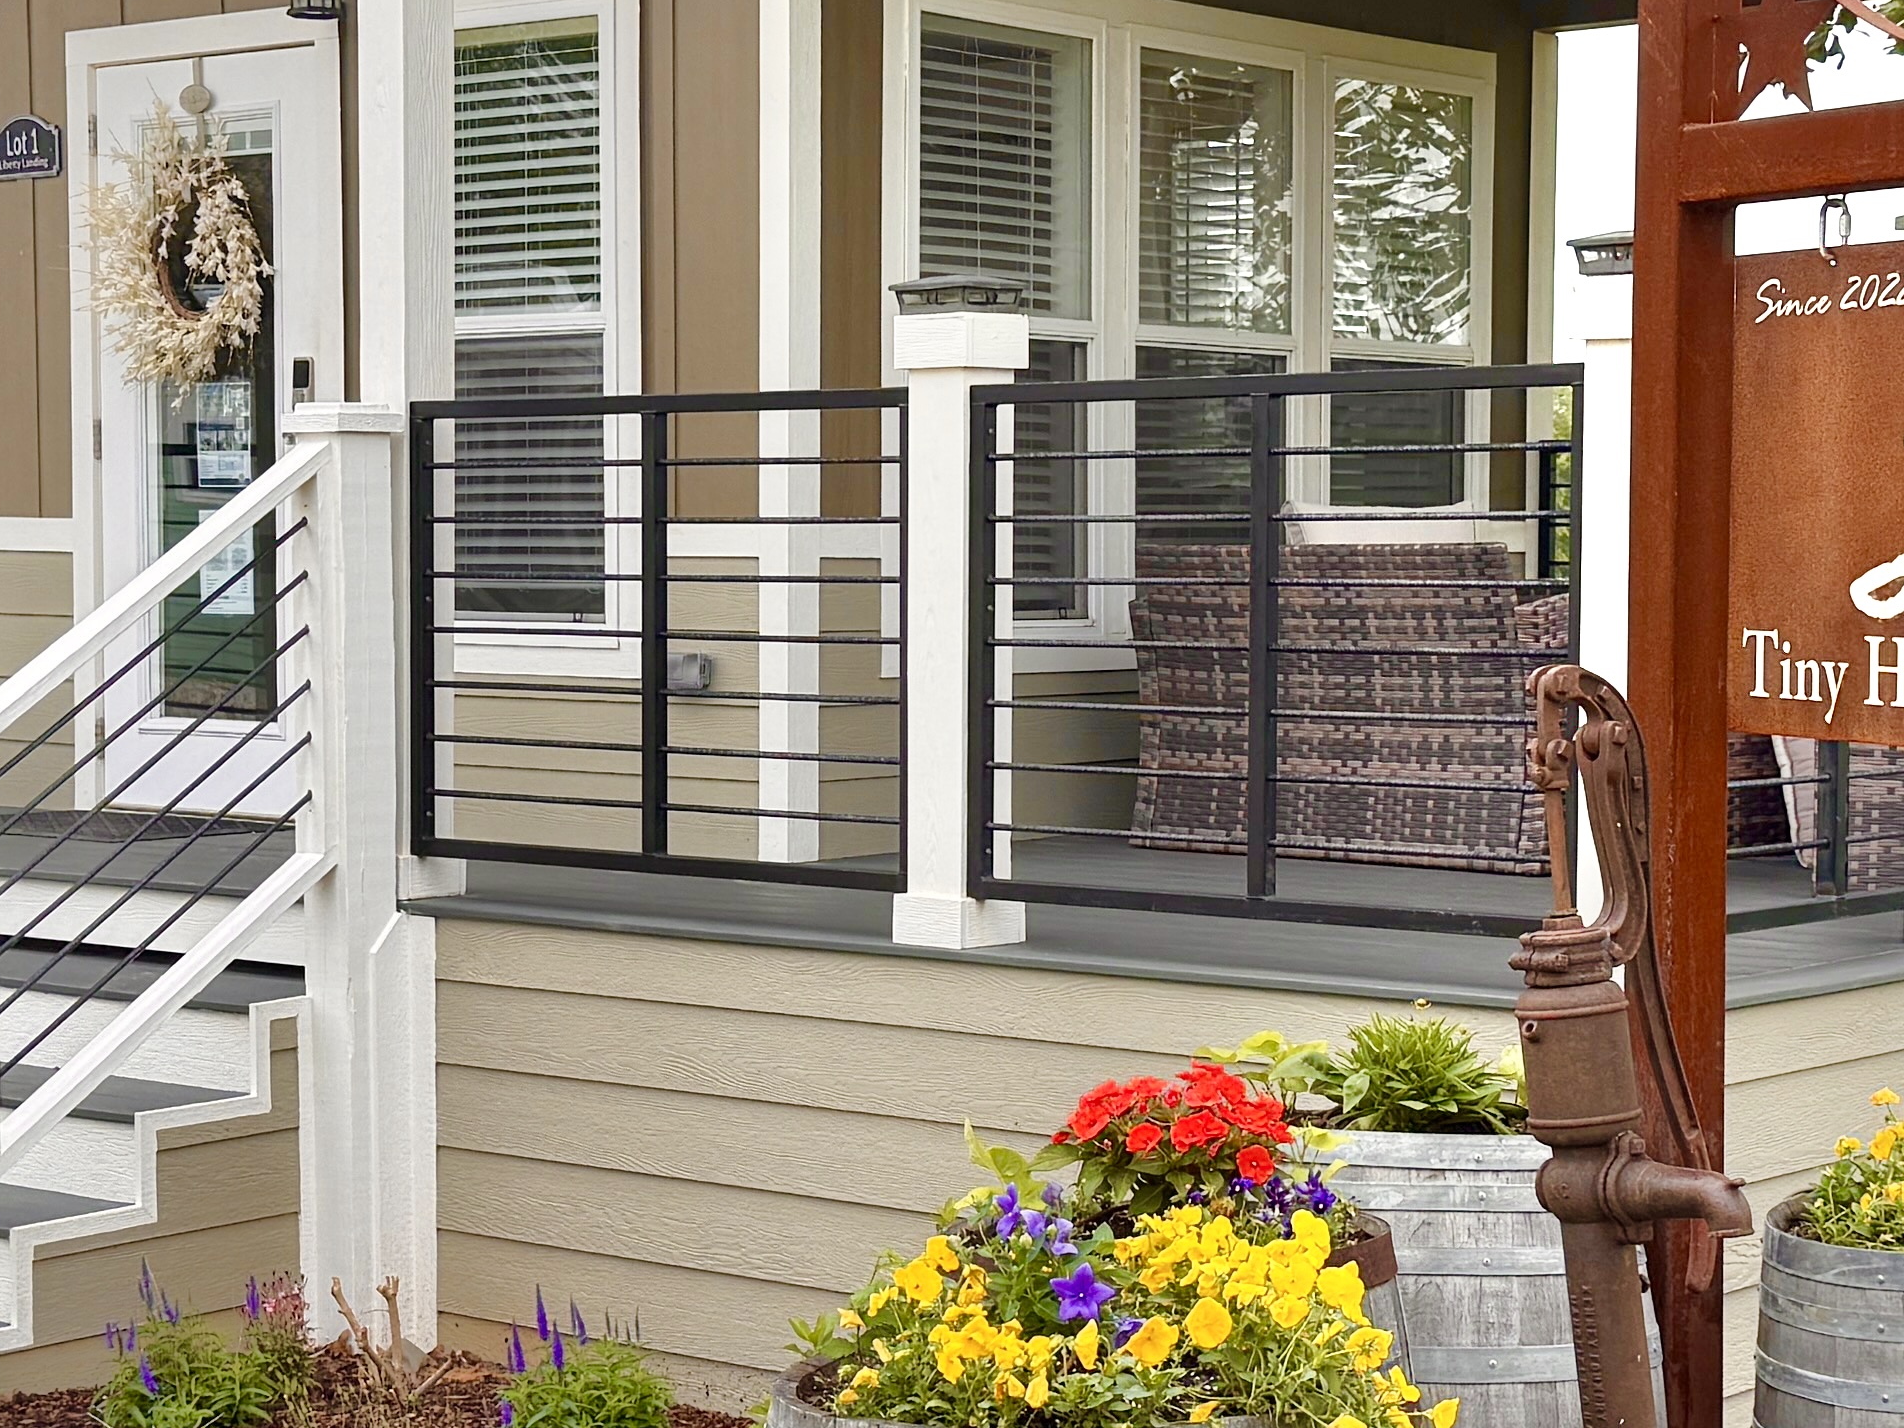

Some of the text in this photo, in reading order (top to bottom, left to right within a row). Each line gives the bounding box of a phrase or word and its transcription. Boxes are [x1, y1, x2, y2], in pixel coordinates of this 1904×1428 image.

[6, 127, 39, 157] Lot 1
[1754, 278, 1832, 324] Since
[1742, 627, 1850, 725] Tiny
